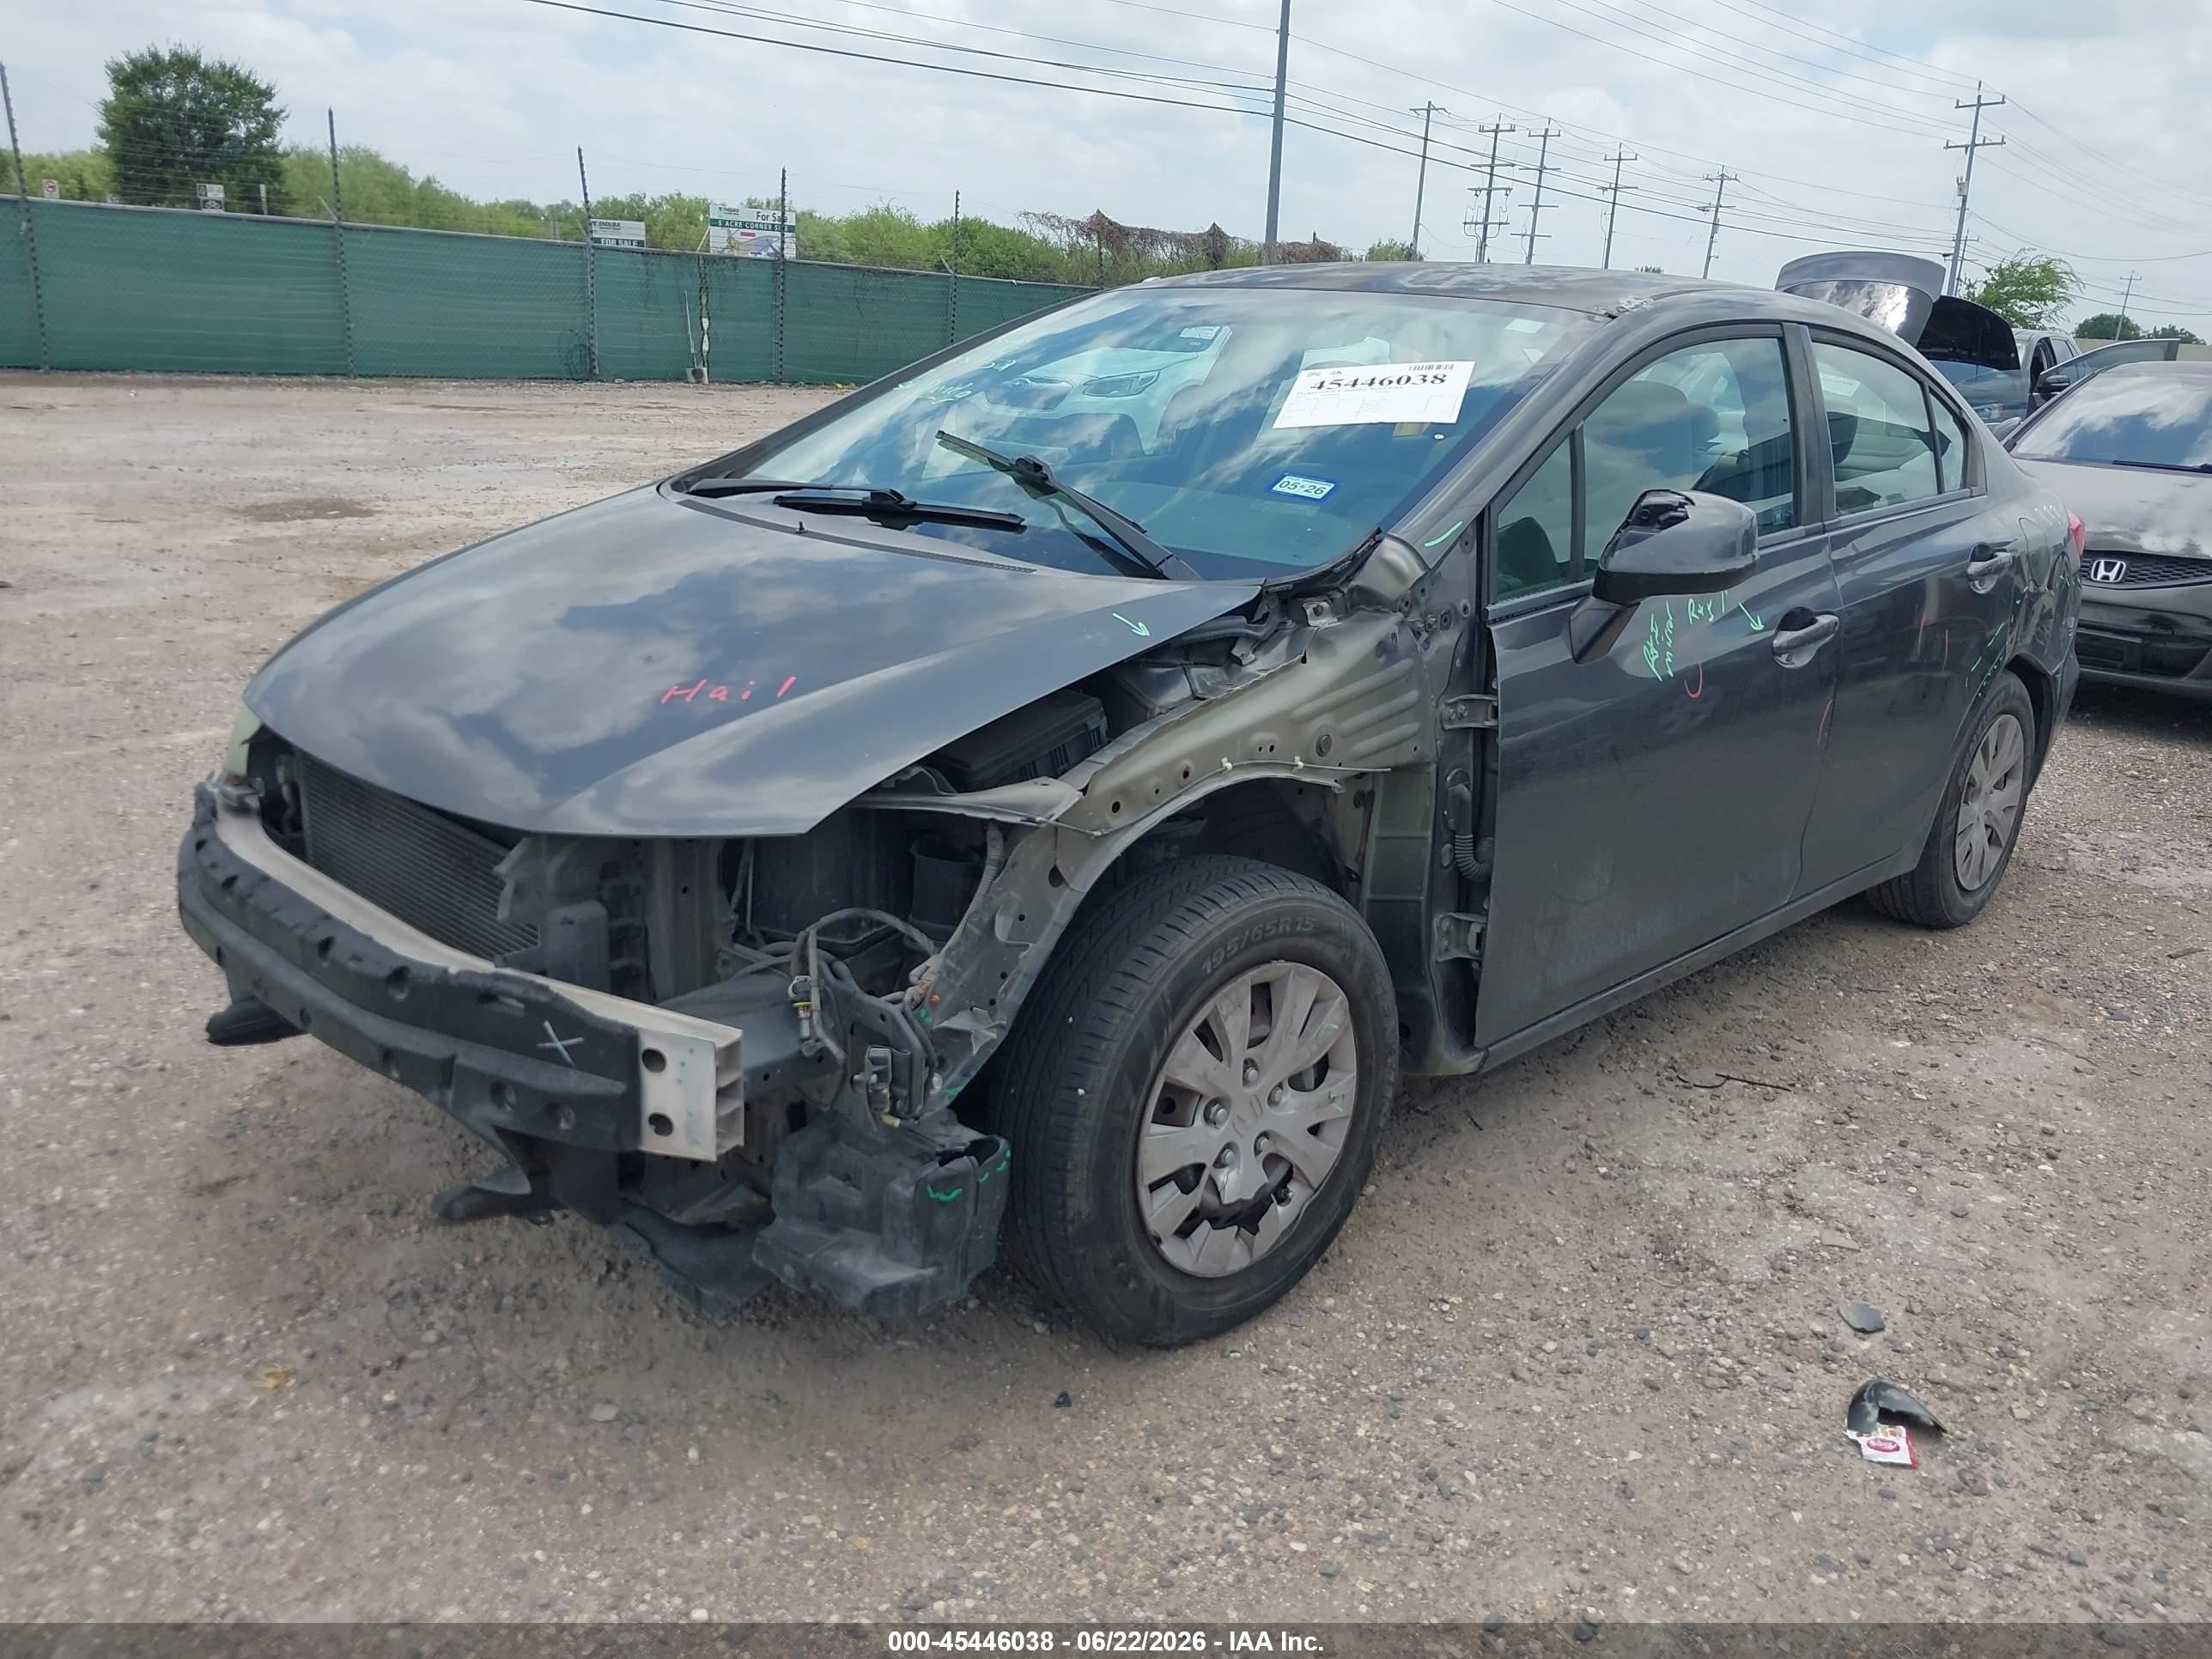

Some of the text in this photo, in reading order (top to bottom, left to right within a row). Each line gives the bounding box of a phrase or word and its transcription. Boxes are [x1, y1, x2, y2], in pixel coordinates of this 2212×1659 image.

[756, 211, 788, 223] For Sae
[601, 238, 638, 247] FOR SALE
[1310, 373, 1448, 390] 45446038
[660, 675, 797, 704] Hail
